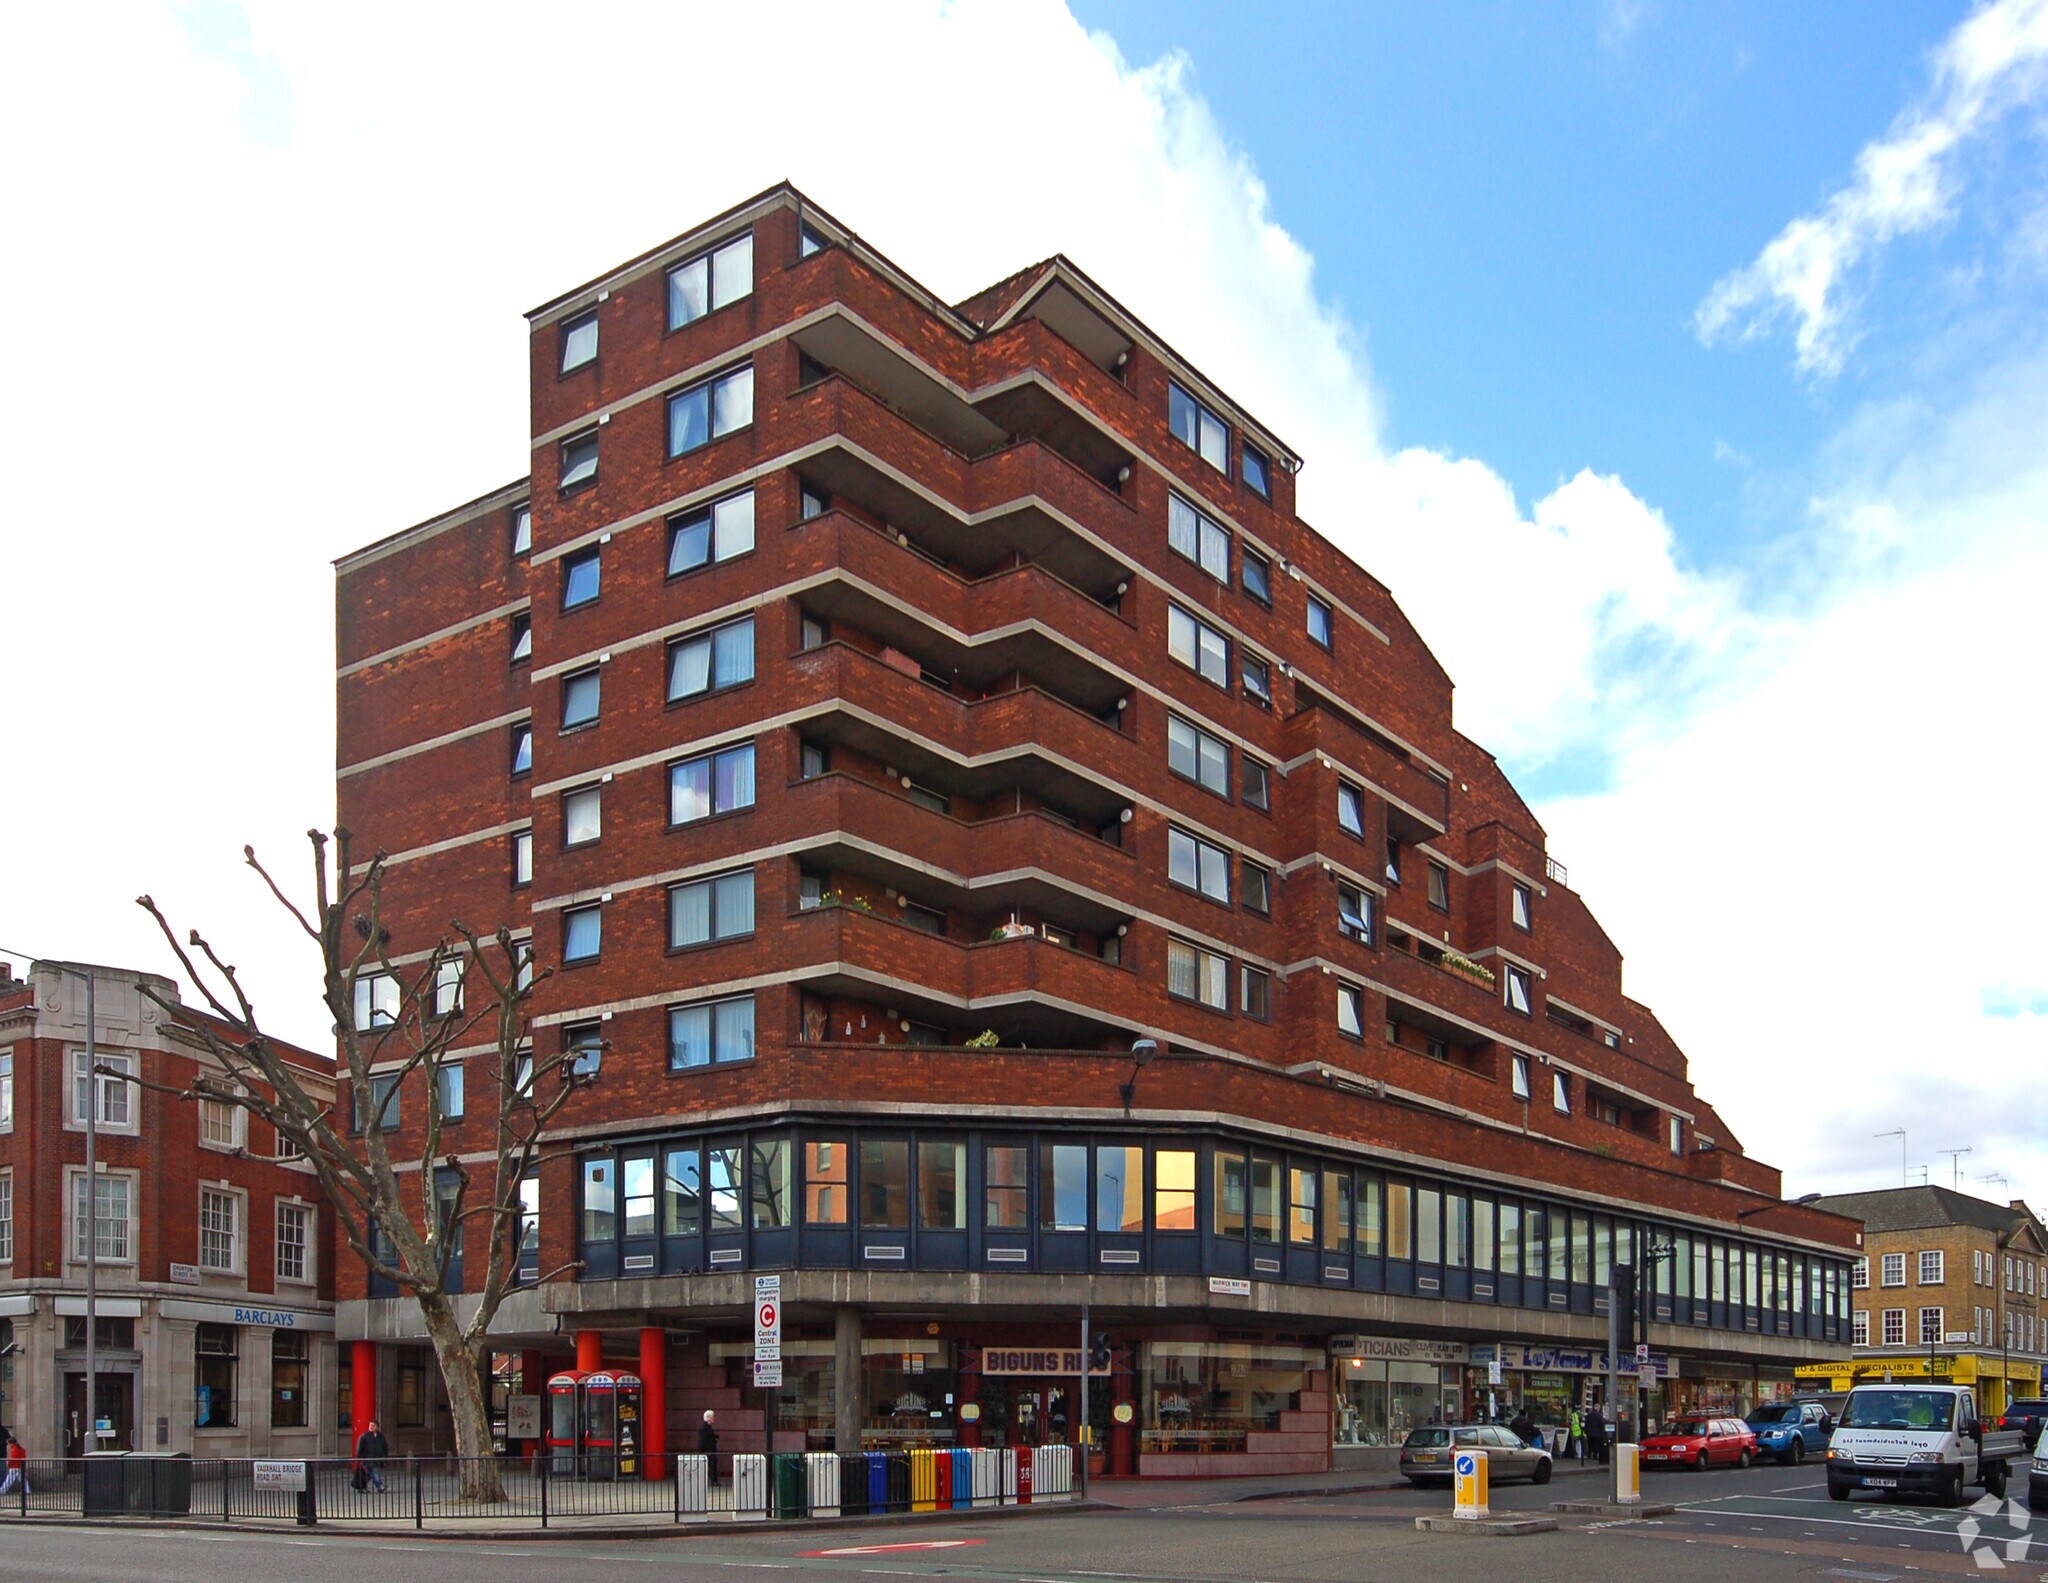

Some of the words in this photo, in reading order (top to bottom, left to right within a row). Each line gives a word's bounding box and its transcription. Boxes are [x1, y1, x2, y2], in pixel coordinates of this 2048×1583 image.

[234, 1308, 295, 1327] BARCLAYS
[760, 1305, 775, 1327] C
[759, 1337, 775, 1345] ZONE
[1360, 1340, 1410, 1357] TICIANS
[987, 1352, 1059, 1371] BIGUNS
[1523, 1345, 1593, 1369] Leyland
[1817, 1364, 1851, 1372] DIGITAL
[1854, 1363, 1915, 1372] SPECIALISTS
[256, 1473, 270, 1481] ROAD
[271, 1473, 281, 1481] SW1
[282, 1465, 302, 1473] BRIDGE
